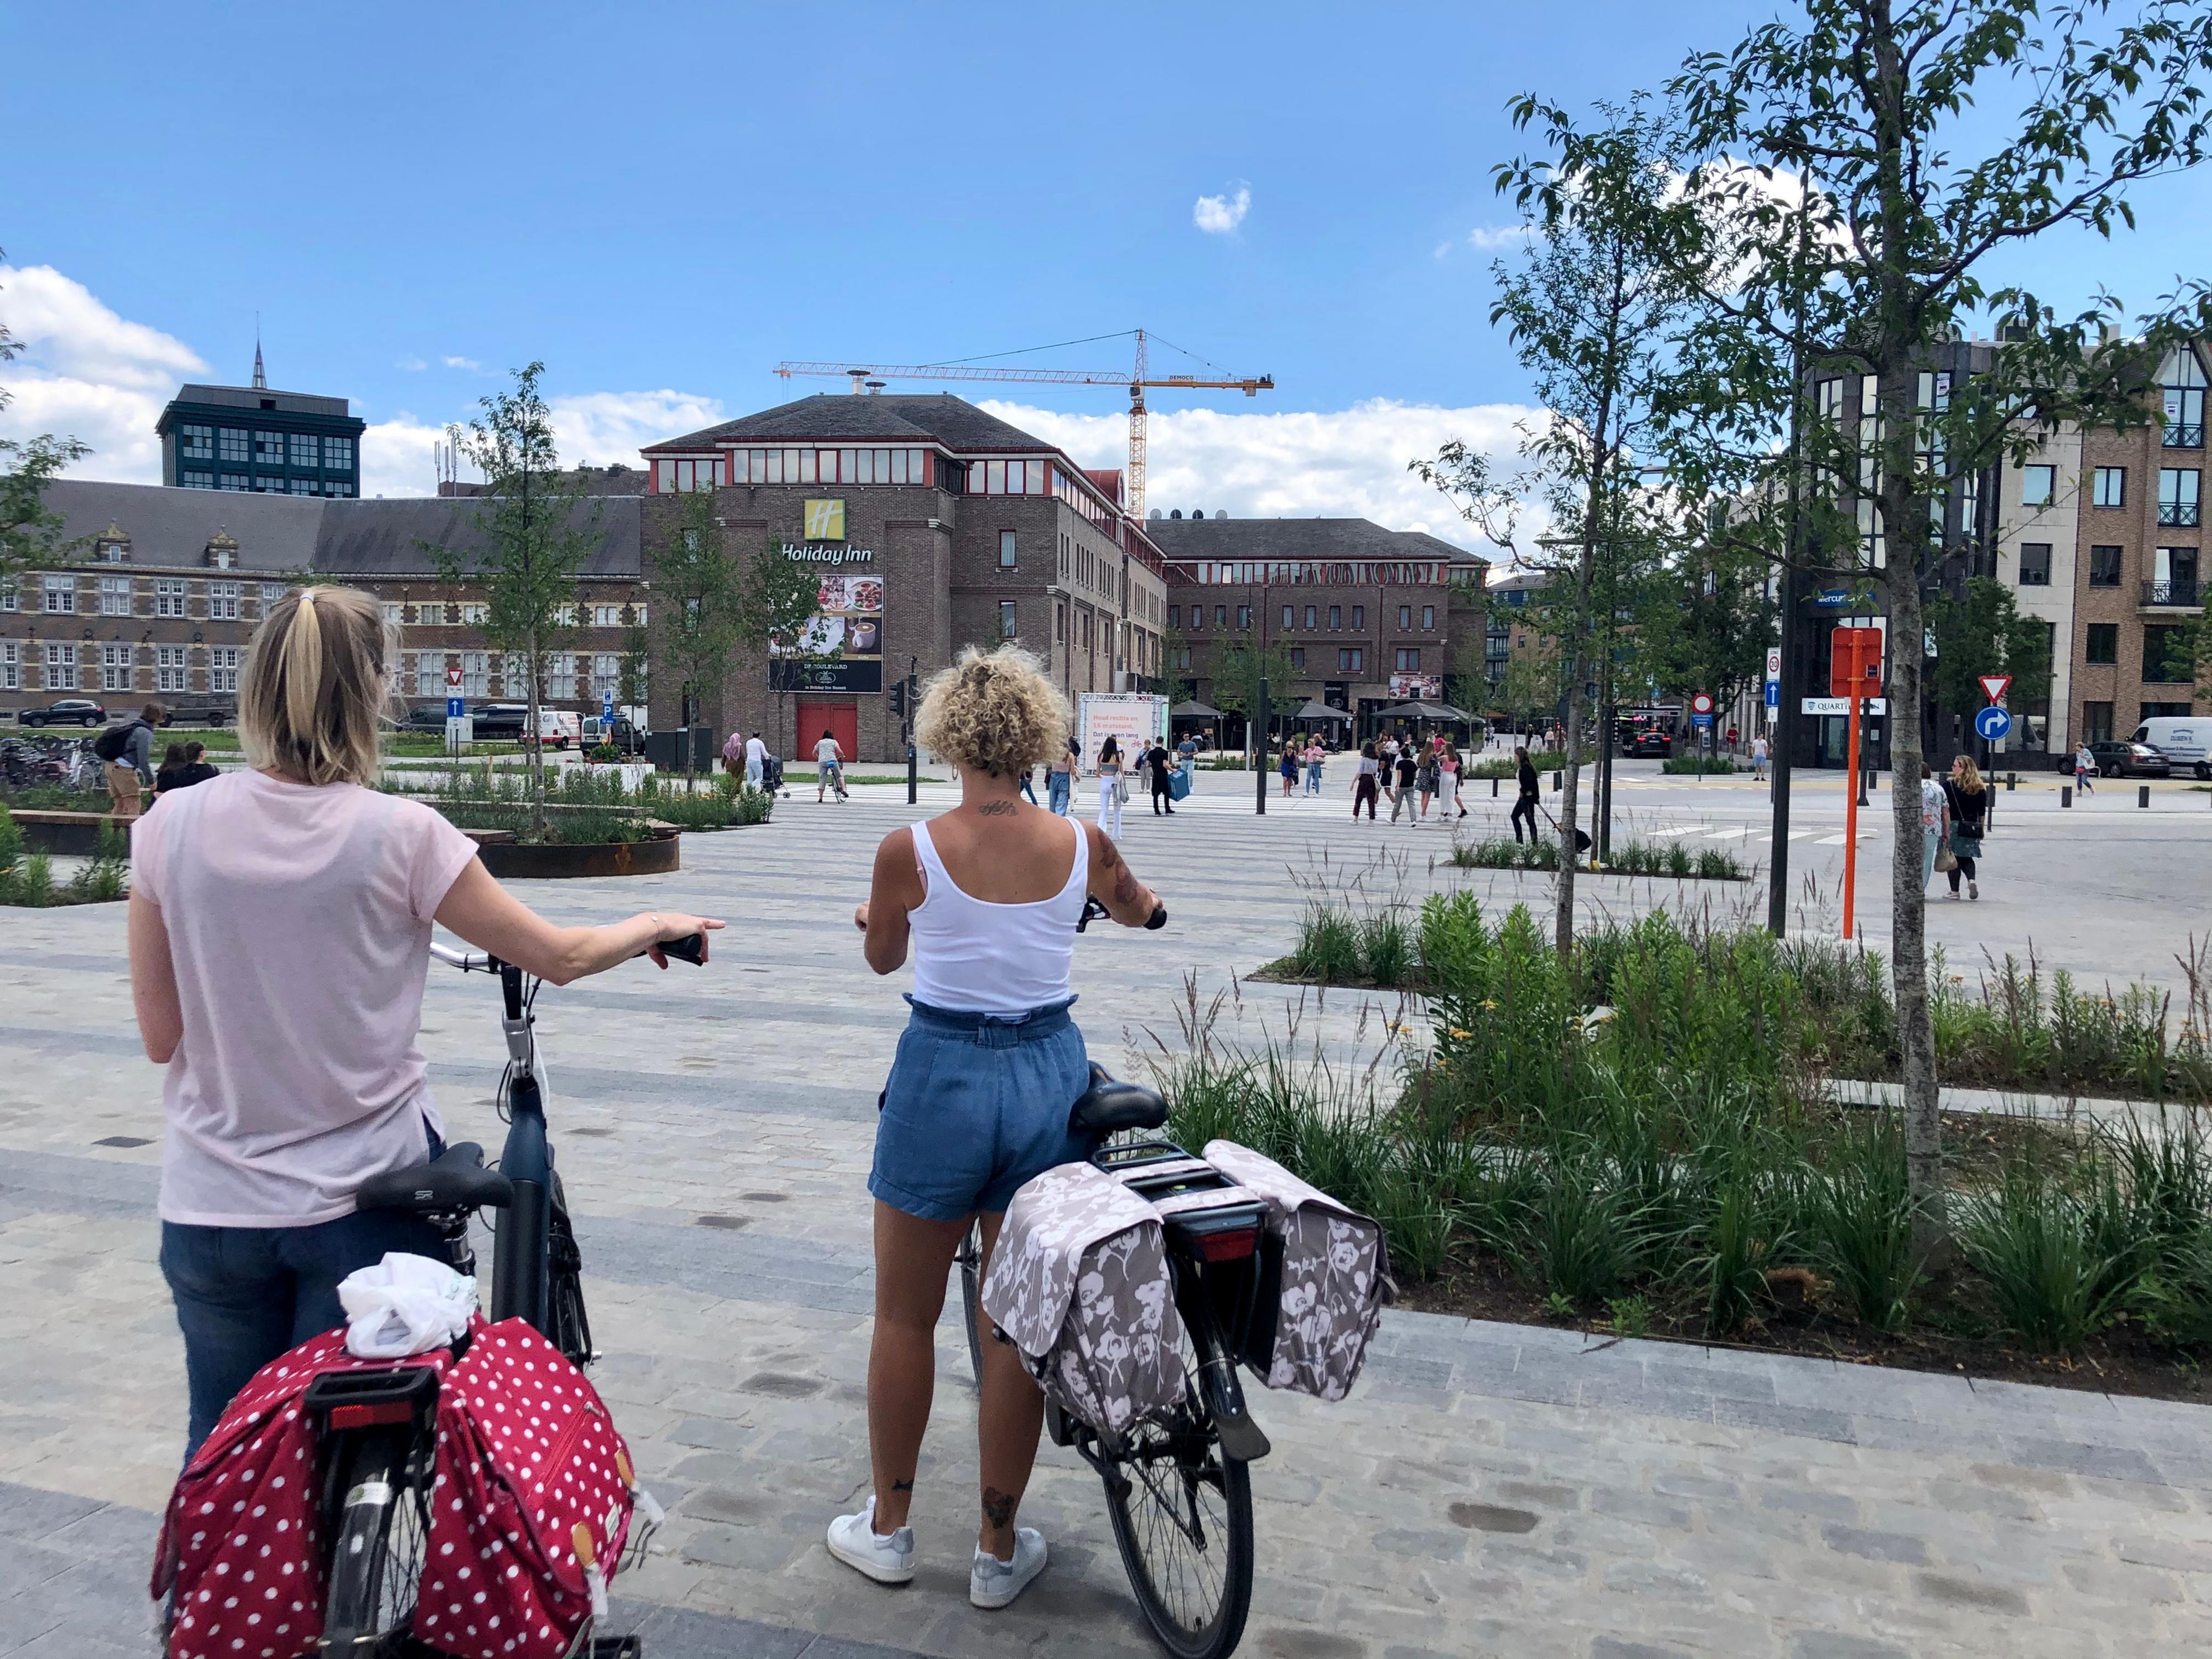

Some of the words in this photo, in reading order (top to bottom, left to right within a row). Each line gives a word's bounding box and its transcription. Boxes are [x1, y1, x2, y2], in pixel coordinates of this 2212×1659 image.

[782, 544, 843, 565] Holiday
[846, 545, 872, 561] Inn
[604, 706, 611, 716] P
